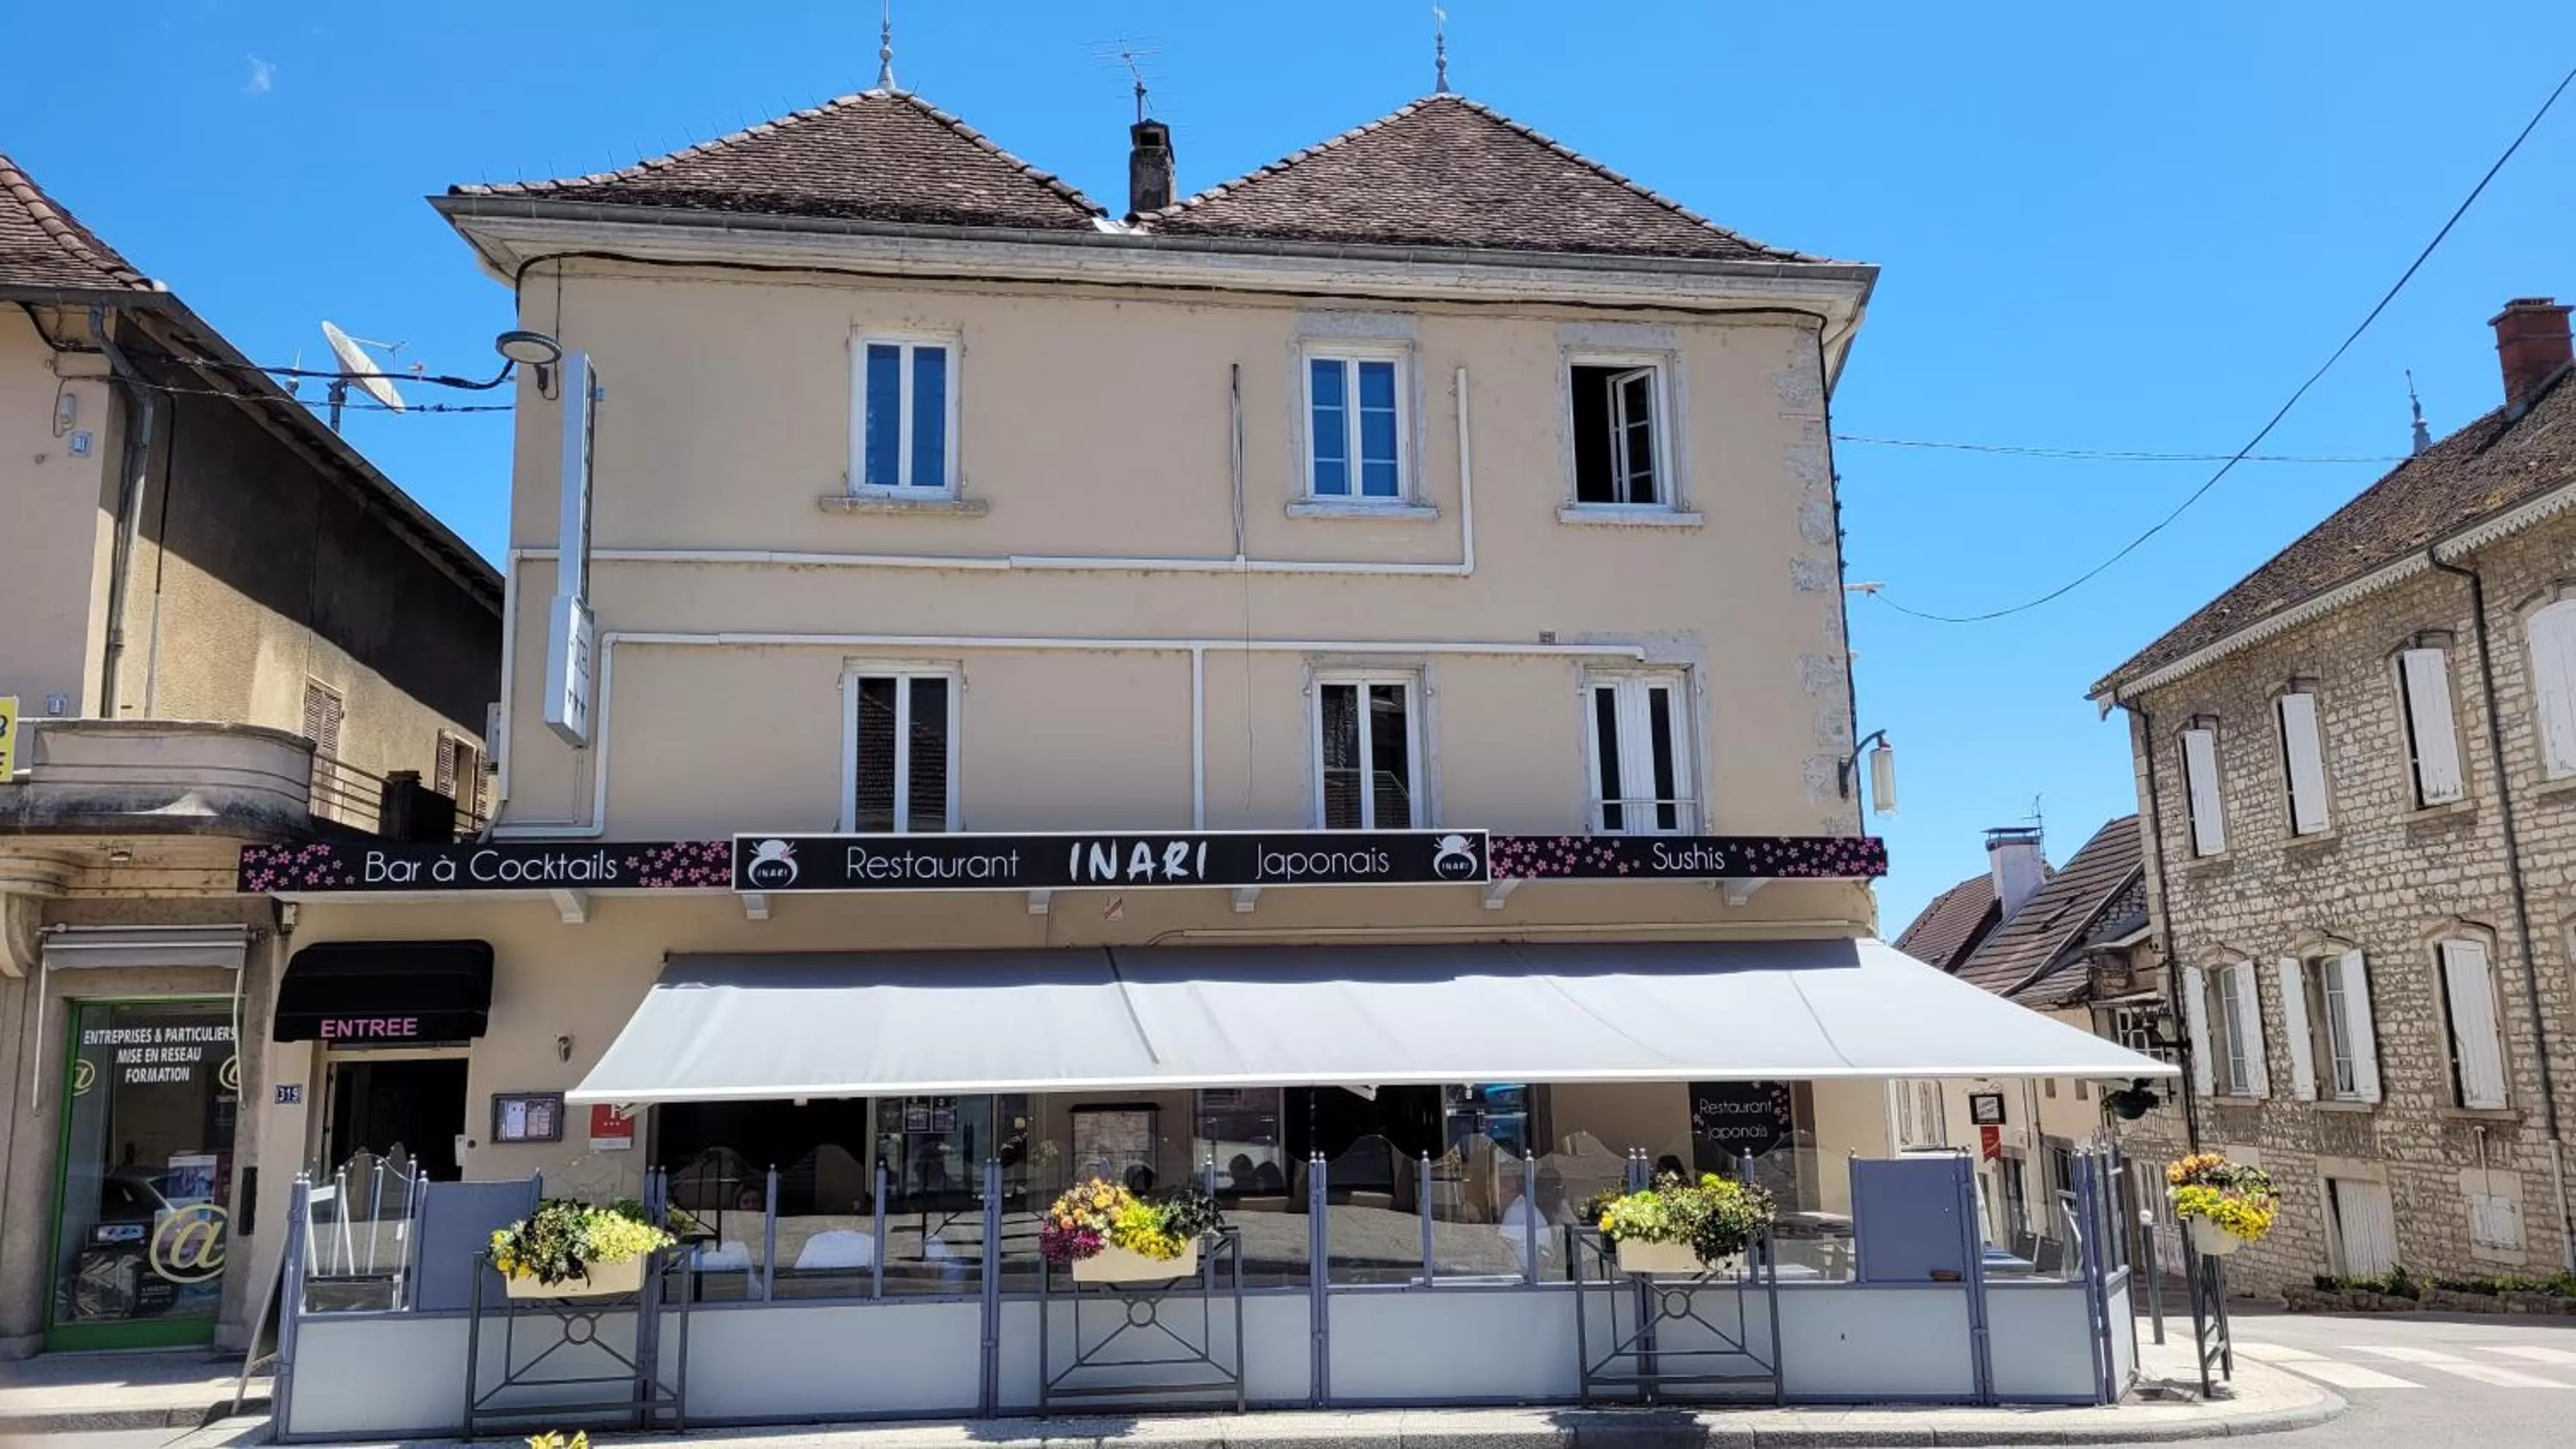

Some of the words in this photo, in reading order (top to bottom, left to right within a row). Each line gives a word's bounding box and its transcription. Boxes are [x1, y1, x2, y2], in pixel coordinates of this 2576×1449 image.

[846, 846, 1021, 880] Restaurant
[1068, 839, 1208, 882] INARI
[1255, 842, 1390, 882] Japonais
[1651, 841, 1726, 870] Sushis
[364, 850, 422, 882] Bar
[432, 853, 457, 882] à
[470, 849, 618, 882] Cocktails
[756, 867, 787, 877] INARI
[83, 1028, 152, 1045] ENTREPRISES
[154, 1028, 162, 1044] &
[164, 1026, 236, 1043] PARTICULIERS
[320, 1017, 418, 1038] ENTREE
[116, 1047, 143, 1064] MISE
[145, 1047, 160, 1064] EN
[160, 1046, 203, 1063] RESEAU
[125, 1066, 191, 1083] FORMATION
[1699, 1098, 1772, 1115] Restaurant
